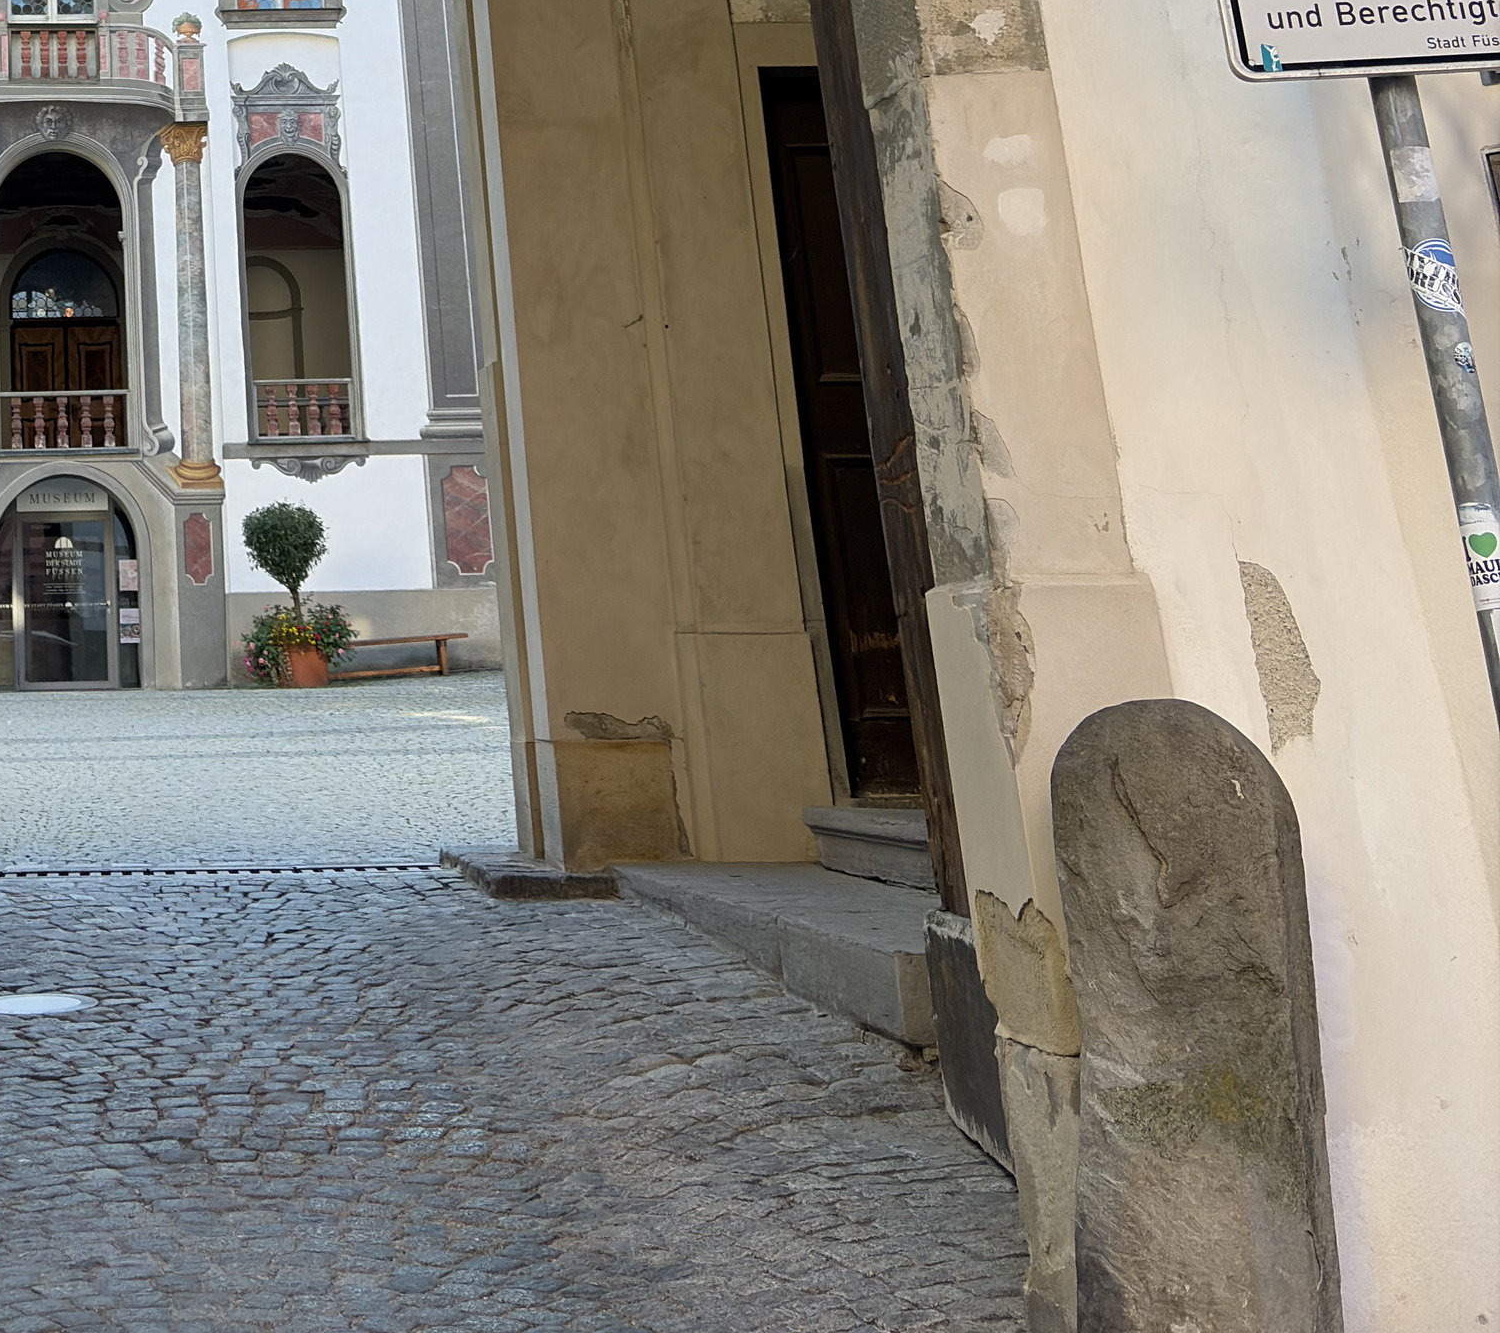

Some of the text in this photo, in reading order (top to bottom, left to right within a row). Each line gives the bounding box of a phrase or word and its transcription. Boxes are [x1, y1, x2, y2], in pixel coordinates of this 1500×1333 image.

[1267, 4, 1323, 29] und
[1427, 34, 1500, 49] Stadt Füs
[29, 493, 95, 504] MUSEUM
[45, 567, 83, 575] FÜSSEN
[1470, 572, 1500, 587] DASC
